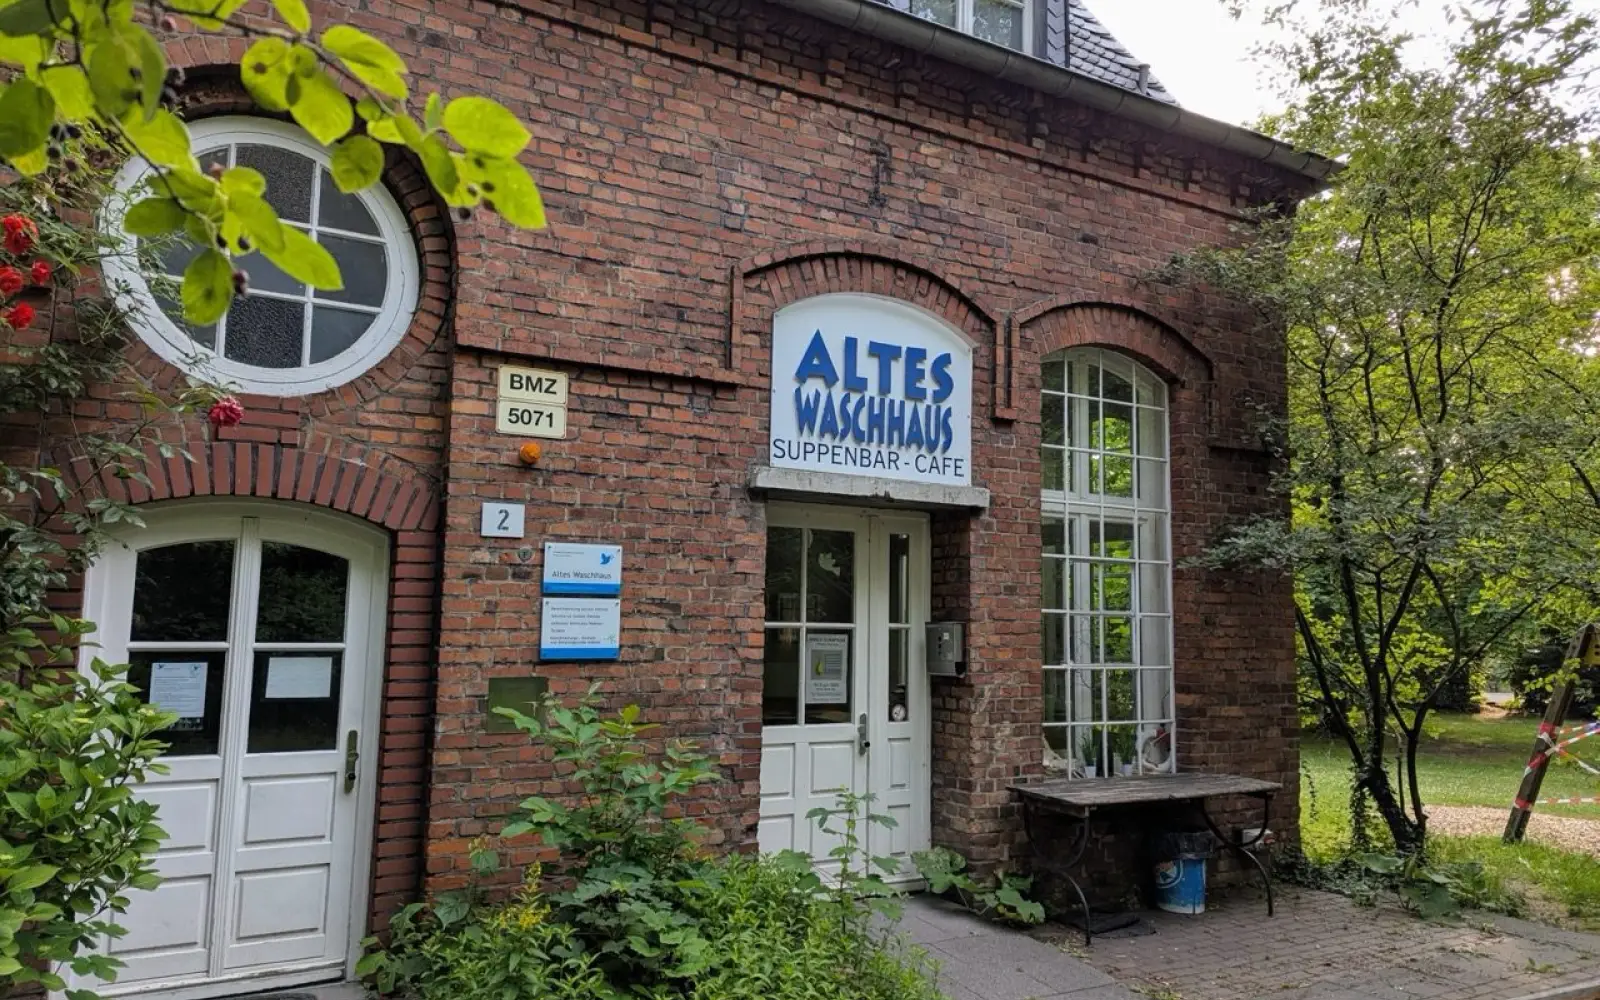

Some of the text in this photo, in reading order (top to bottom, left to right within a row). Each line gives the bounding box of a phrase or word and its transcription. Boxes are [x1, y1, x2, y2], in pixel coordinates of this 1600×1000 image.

[795, 328, 954, 404] ALTES
[509, 373, 557, 395] BMZ
[508, 407, 554, 428] 5071
[795, 386, 953, 454] WASCHHAUS
[773, 439, 900, 470] SUPPENBAR
[914, 453, 965, 478] CAFE
[497, 508, 510, 531] 2
[552, 570, 612, 580] Altes Waschhaus
